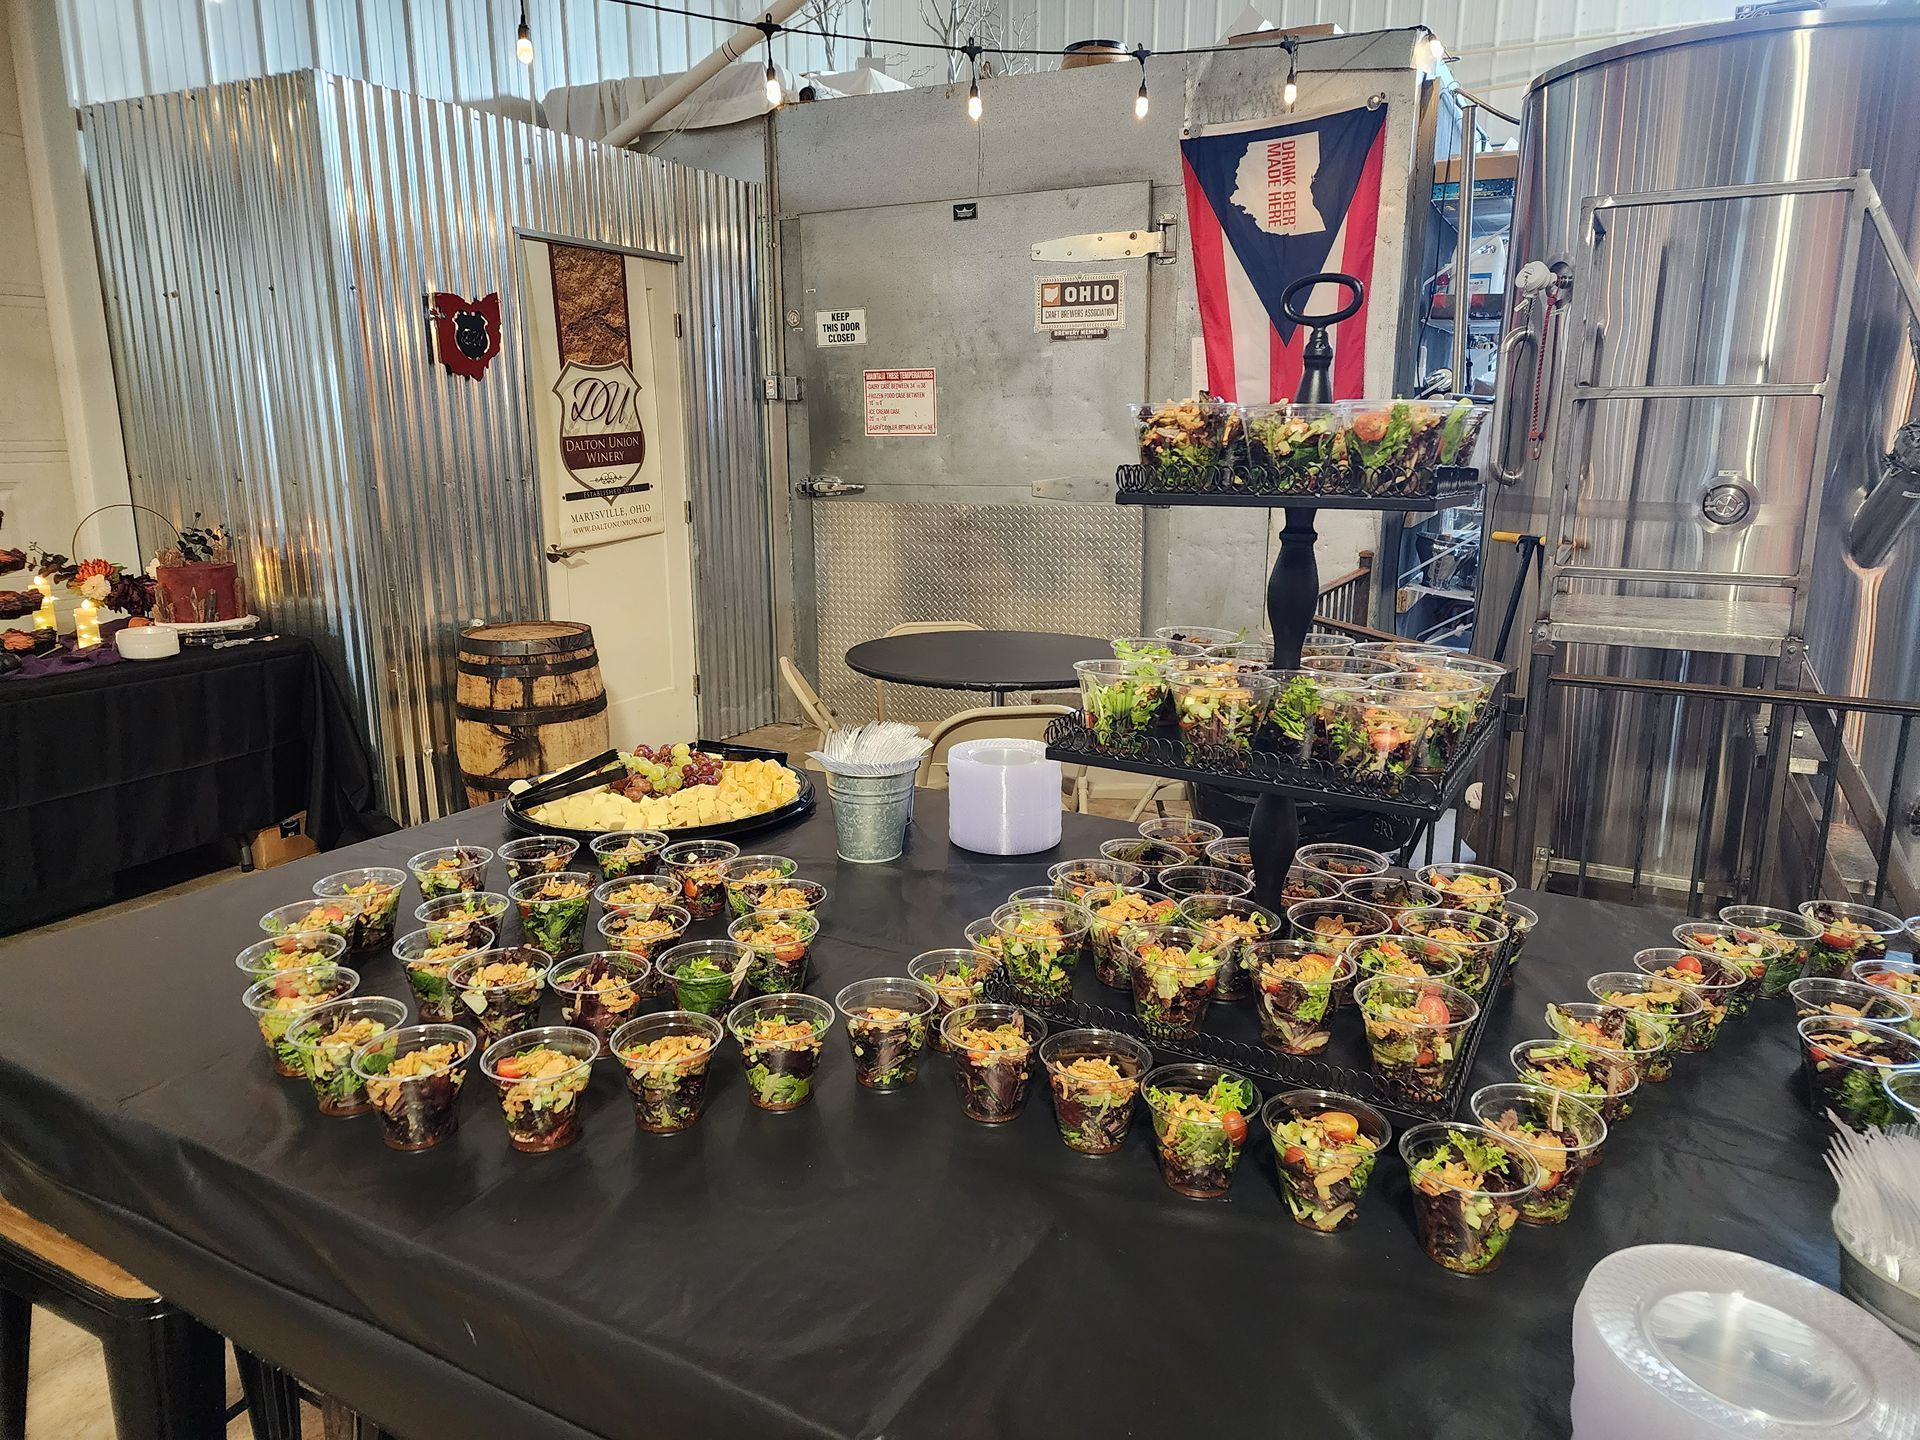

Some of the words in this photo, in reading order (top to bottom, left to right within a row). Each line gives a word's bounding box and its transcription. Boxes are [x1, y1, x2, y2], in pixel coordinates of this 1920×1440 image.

[1267, 142, 1281, 188] MADE
[1281, 140, 1296, 186] DRINK
[1268, 191, 1282, 228] HERE
[1282, 191, 1296, 226] BEER
[1064, 284, 1115, 303] OHIO
[831, 312, 850, 321] KEEP
[1045, 310, 1060, 319] CRAFT
[1061, 309, 1084, 318] BREWERS
[1084, 307, 1115, 318] ASSOCIATION
[822, 323, 839, 332] THIS
[840, 322, 860, 331] DOOR
[828, 333, 856, 343] CLOSED
[566, 438, 606, 452] DALTON
[608, 436, 640, 448] UNION
[586, 450, 625, 463] WINERY
[583, 487, 621, 498] ESTABLISHED
[622, 486, 636, 494] 2014
[570, 507, 628, 523] MARYSVILLE,
[629, 503, 651, 515] OHIO
[572, 516, 652, 534] WWW.DALTONUNION.COM
